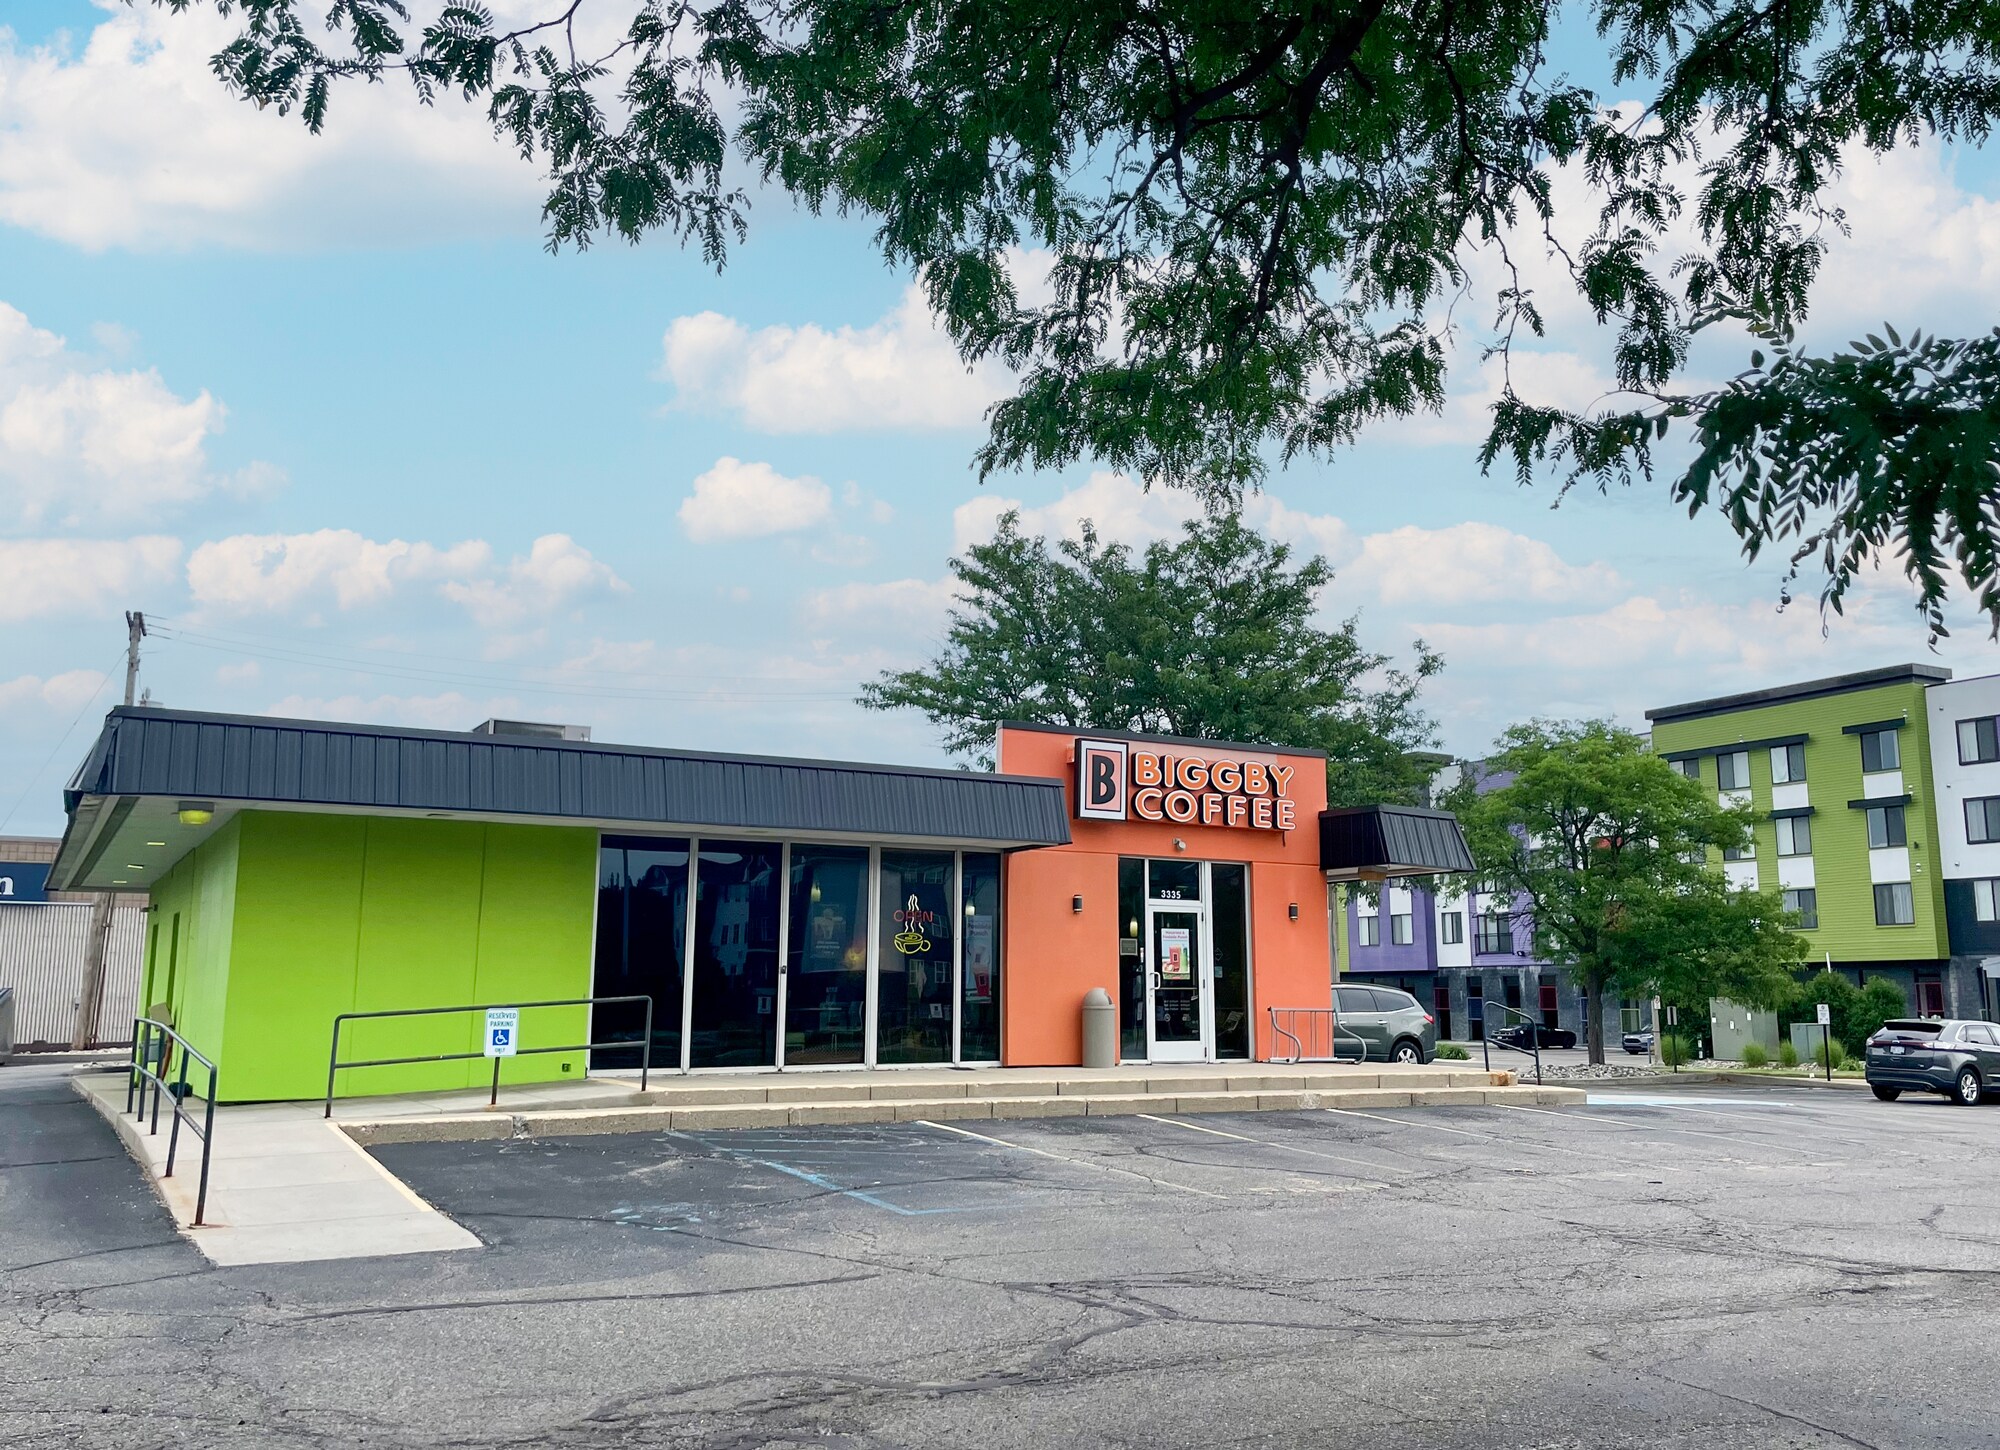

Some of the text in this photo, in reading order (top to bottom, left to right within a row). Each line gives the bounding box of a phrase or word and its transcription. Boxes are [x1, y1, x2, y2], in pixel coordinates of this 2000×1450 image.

[1092, 755, 1116, 804] B
[1133, 751, 1296, 797] BIGGBY
[1133, 787, 1296, 830] COFFEE
[894, 909, 934, 923] OPEN
[1161, 890, 1181, 899] 3335
